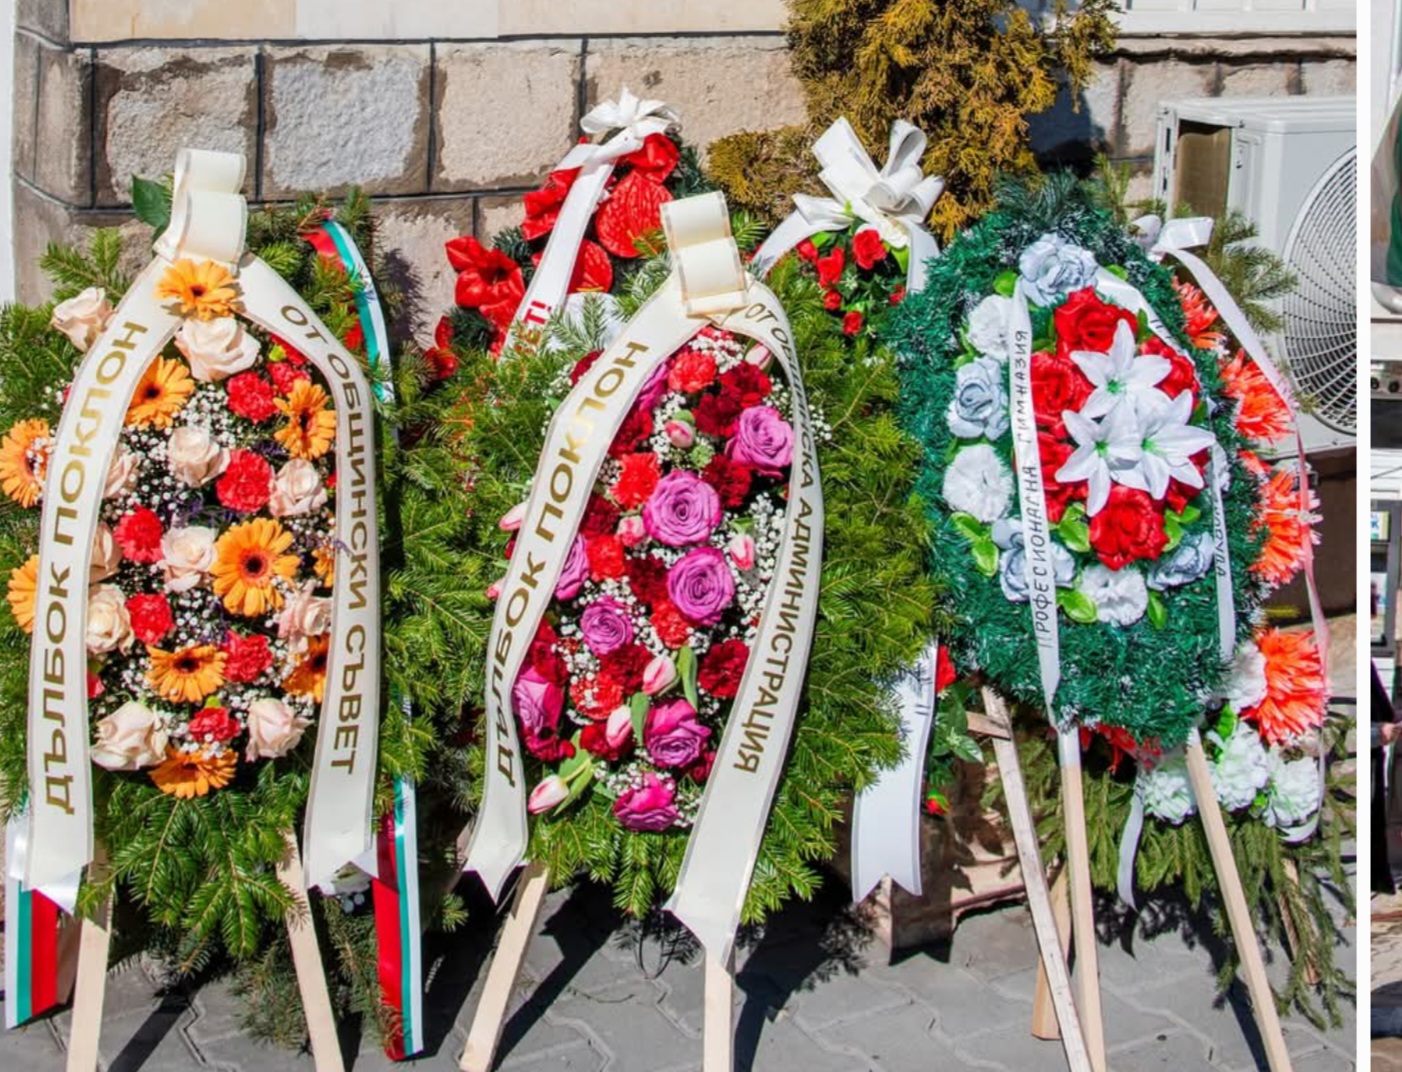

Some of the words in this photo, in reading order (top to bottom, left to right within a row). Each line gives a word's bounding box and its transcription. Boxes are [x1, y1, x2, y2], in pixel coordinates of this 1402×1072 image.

[281, 304, 329, 345] ОТ
[744, 302, 779, 326] ОТ
[772, 327, 815, 489] ОБЩИНСКА
[1013, 330, 1035, 444] ГИМНАЗИЯ
[53, 321, 149, 545] ПОКЛОН
[328, 353, 368, 611] ОБЩИНСКИ
[491, 551, 546, 788] ДЪЛБОК
[535, 341, 650, 543] ПОКЛОН
[733, 497, 814, 775] АДМИНИСТРАЦИЯ
[43, 562, 76, 816] ДЪЛБОК
[330, 624, 367, 775] СЪВЕТ
